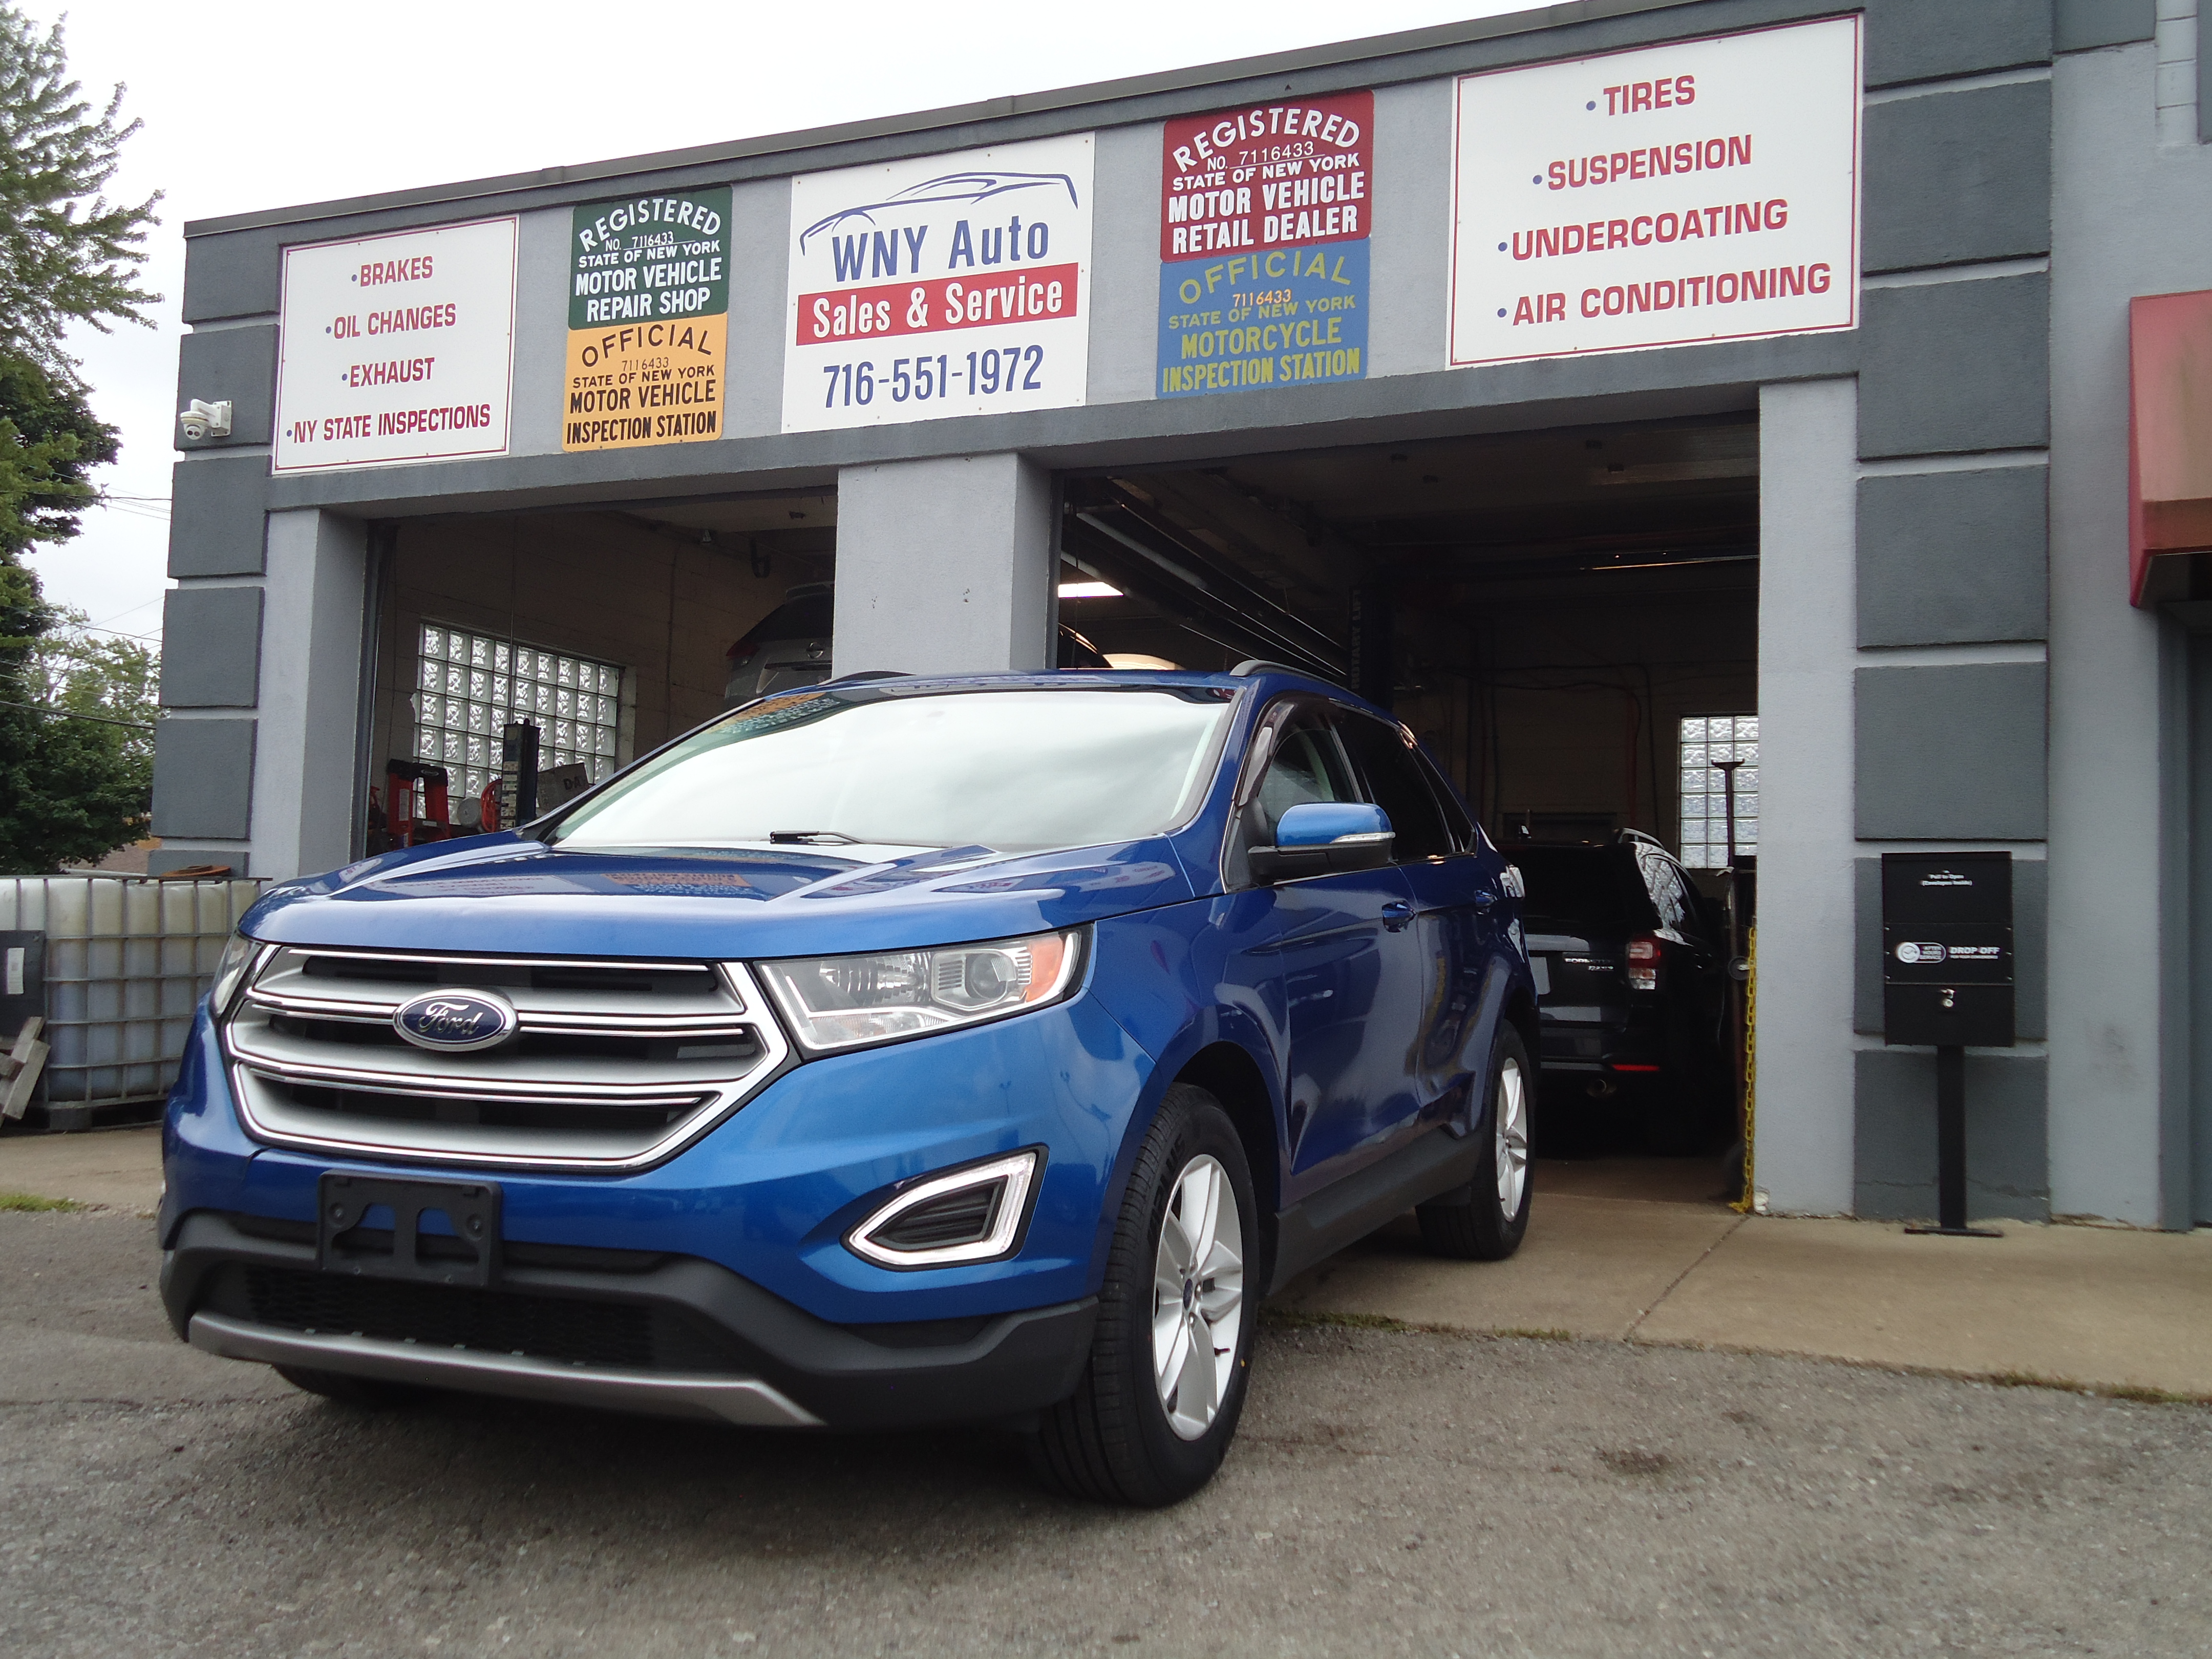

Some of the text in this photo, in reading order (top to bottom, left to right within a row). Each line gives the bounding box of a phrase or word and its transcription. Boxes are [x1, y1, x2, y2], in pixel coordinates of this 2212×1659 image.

[1603, 75, 1695, 116] TIRES
[1173, 108, 1359, 174] REGISTERED
[1207, 141, 1314, 171] NO. 7116433
[1173, 153, 1360, 190] STATE OF NEW YORK
[1548, 134, 1752, 190] SUSPENSION
[1168, 172, 1365, 223] MOTOR VEHICLE
[579, 198, 721, 252] REGISTERED
[605, 231, 674, 251] NO. 7116433
[1172, 205, 1357, 254] RETAIL DEALER
[1512, 198, 1788, 261] UNDERCOATING
[578, 240, 720, 268] STATE OF NEW YORK
[832, 215, 1049, 282] WNY Auto
[360, 256, 433, 287] BRAKES
[575, 258, 722, 296] MOTOR VEHICLE
[1179, 251, 1351, 304] OFFICIAL
[586, 287, 710, 322] REPAIR SHOP
[813, 275, 1062, 337] Sales & Service
[1168, 295, 1355, 330] STATE OF NEW YORK
[1232, 289, 1291, 307] 7116433
[1513, 263, 1831, 326] AIR CONDITIONING
[334, 303, 456, 339] OIL CHANGES
[1181, 317, 1342, 360] MOTORCYCLE
[582, 324, 712, 367] OFFICIAL
[621, 357, 670, 372] 7116433
[350, 357, 435, 387] EXHAUST
[572, 364, 715, 389] STATE OF NEW YORK
[823, 344, 1044, 408] 716-551-1972
[1163, 348, 1360, 393] INSPECTION STATION
[570, 379, 716, 414] MOTOR VEHICLE
[293, 403, 491, 443] NY STATE INSPECTIONS
[566, 410, 716, 444] INSPECTION STATION
[1351, 626, 1360, 689] ROTARY
[418, 1002, 483, 1035] Ford
